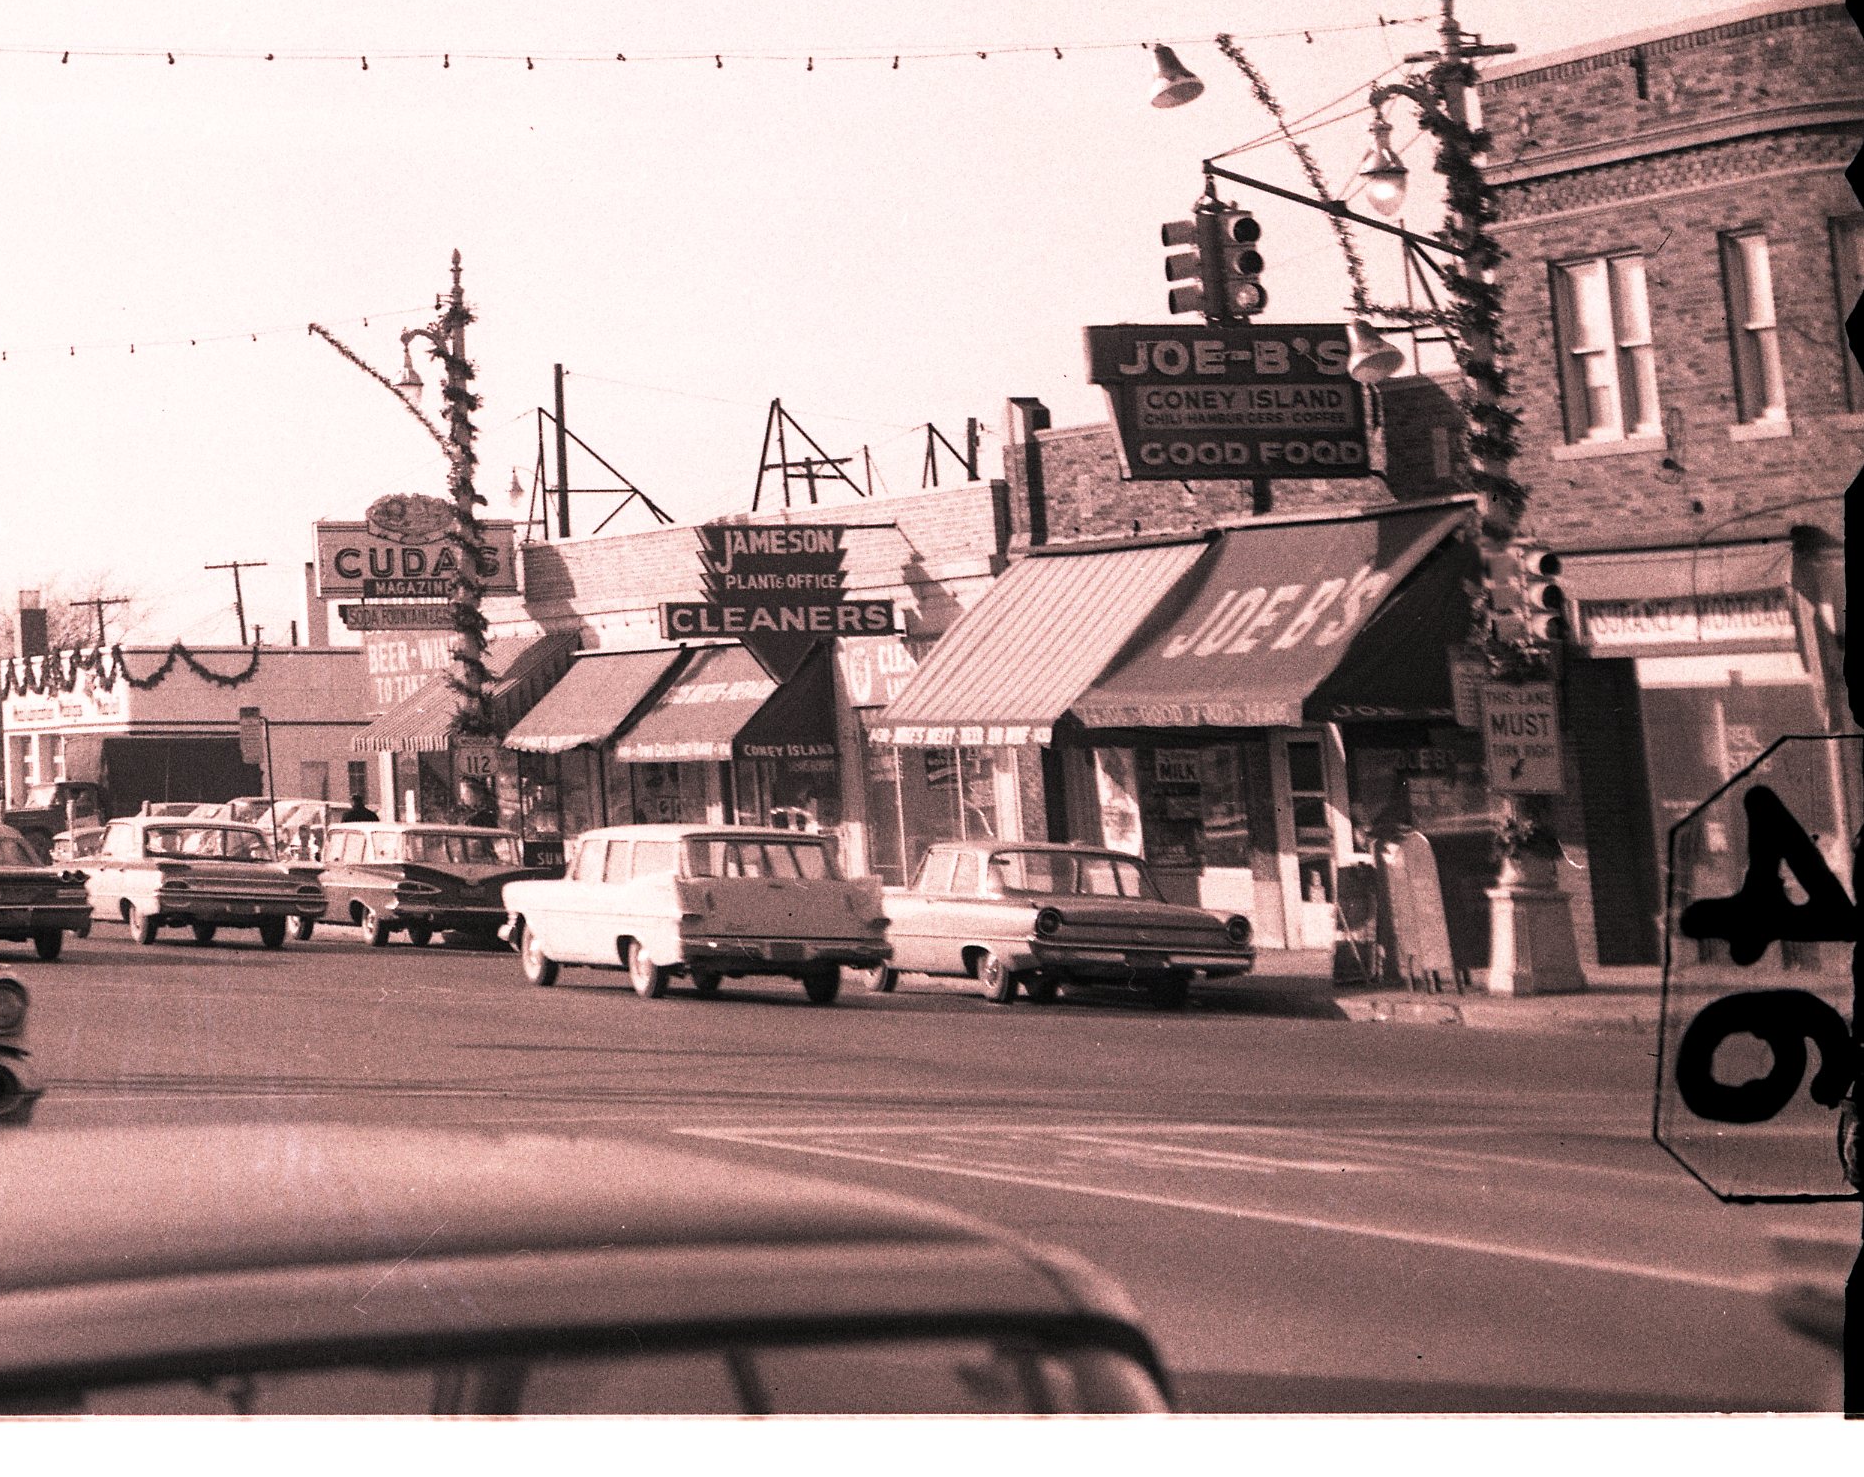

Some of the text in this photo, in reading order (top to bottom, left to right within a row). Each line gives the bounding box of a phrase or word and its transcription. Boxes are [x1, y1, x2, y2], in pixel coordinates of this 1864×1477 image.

[1146, 388, 1342, 411] CONEY ISLAND
[1140, 440, 1365, 466] GOOD FOOD
[714, 529, 835, 574] JAMESON
[786, 573, 837, 588] OFFICE
[672, 605, 890, 633] CLEANERS
[1161, 584, 1307, 659] JOE
[1490, 712, 1551, 738] MUST
[743, 745, 784, 758] CONEY
[466, 754, 491, 774] 112
[1159, 761, 1196, 780] MILK
